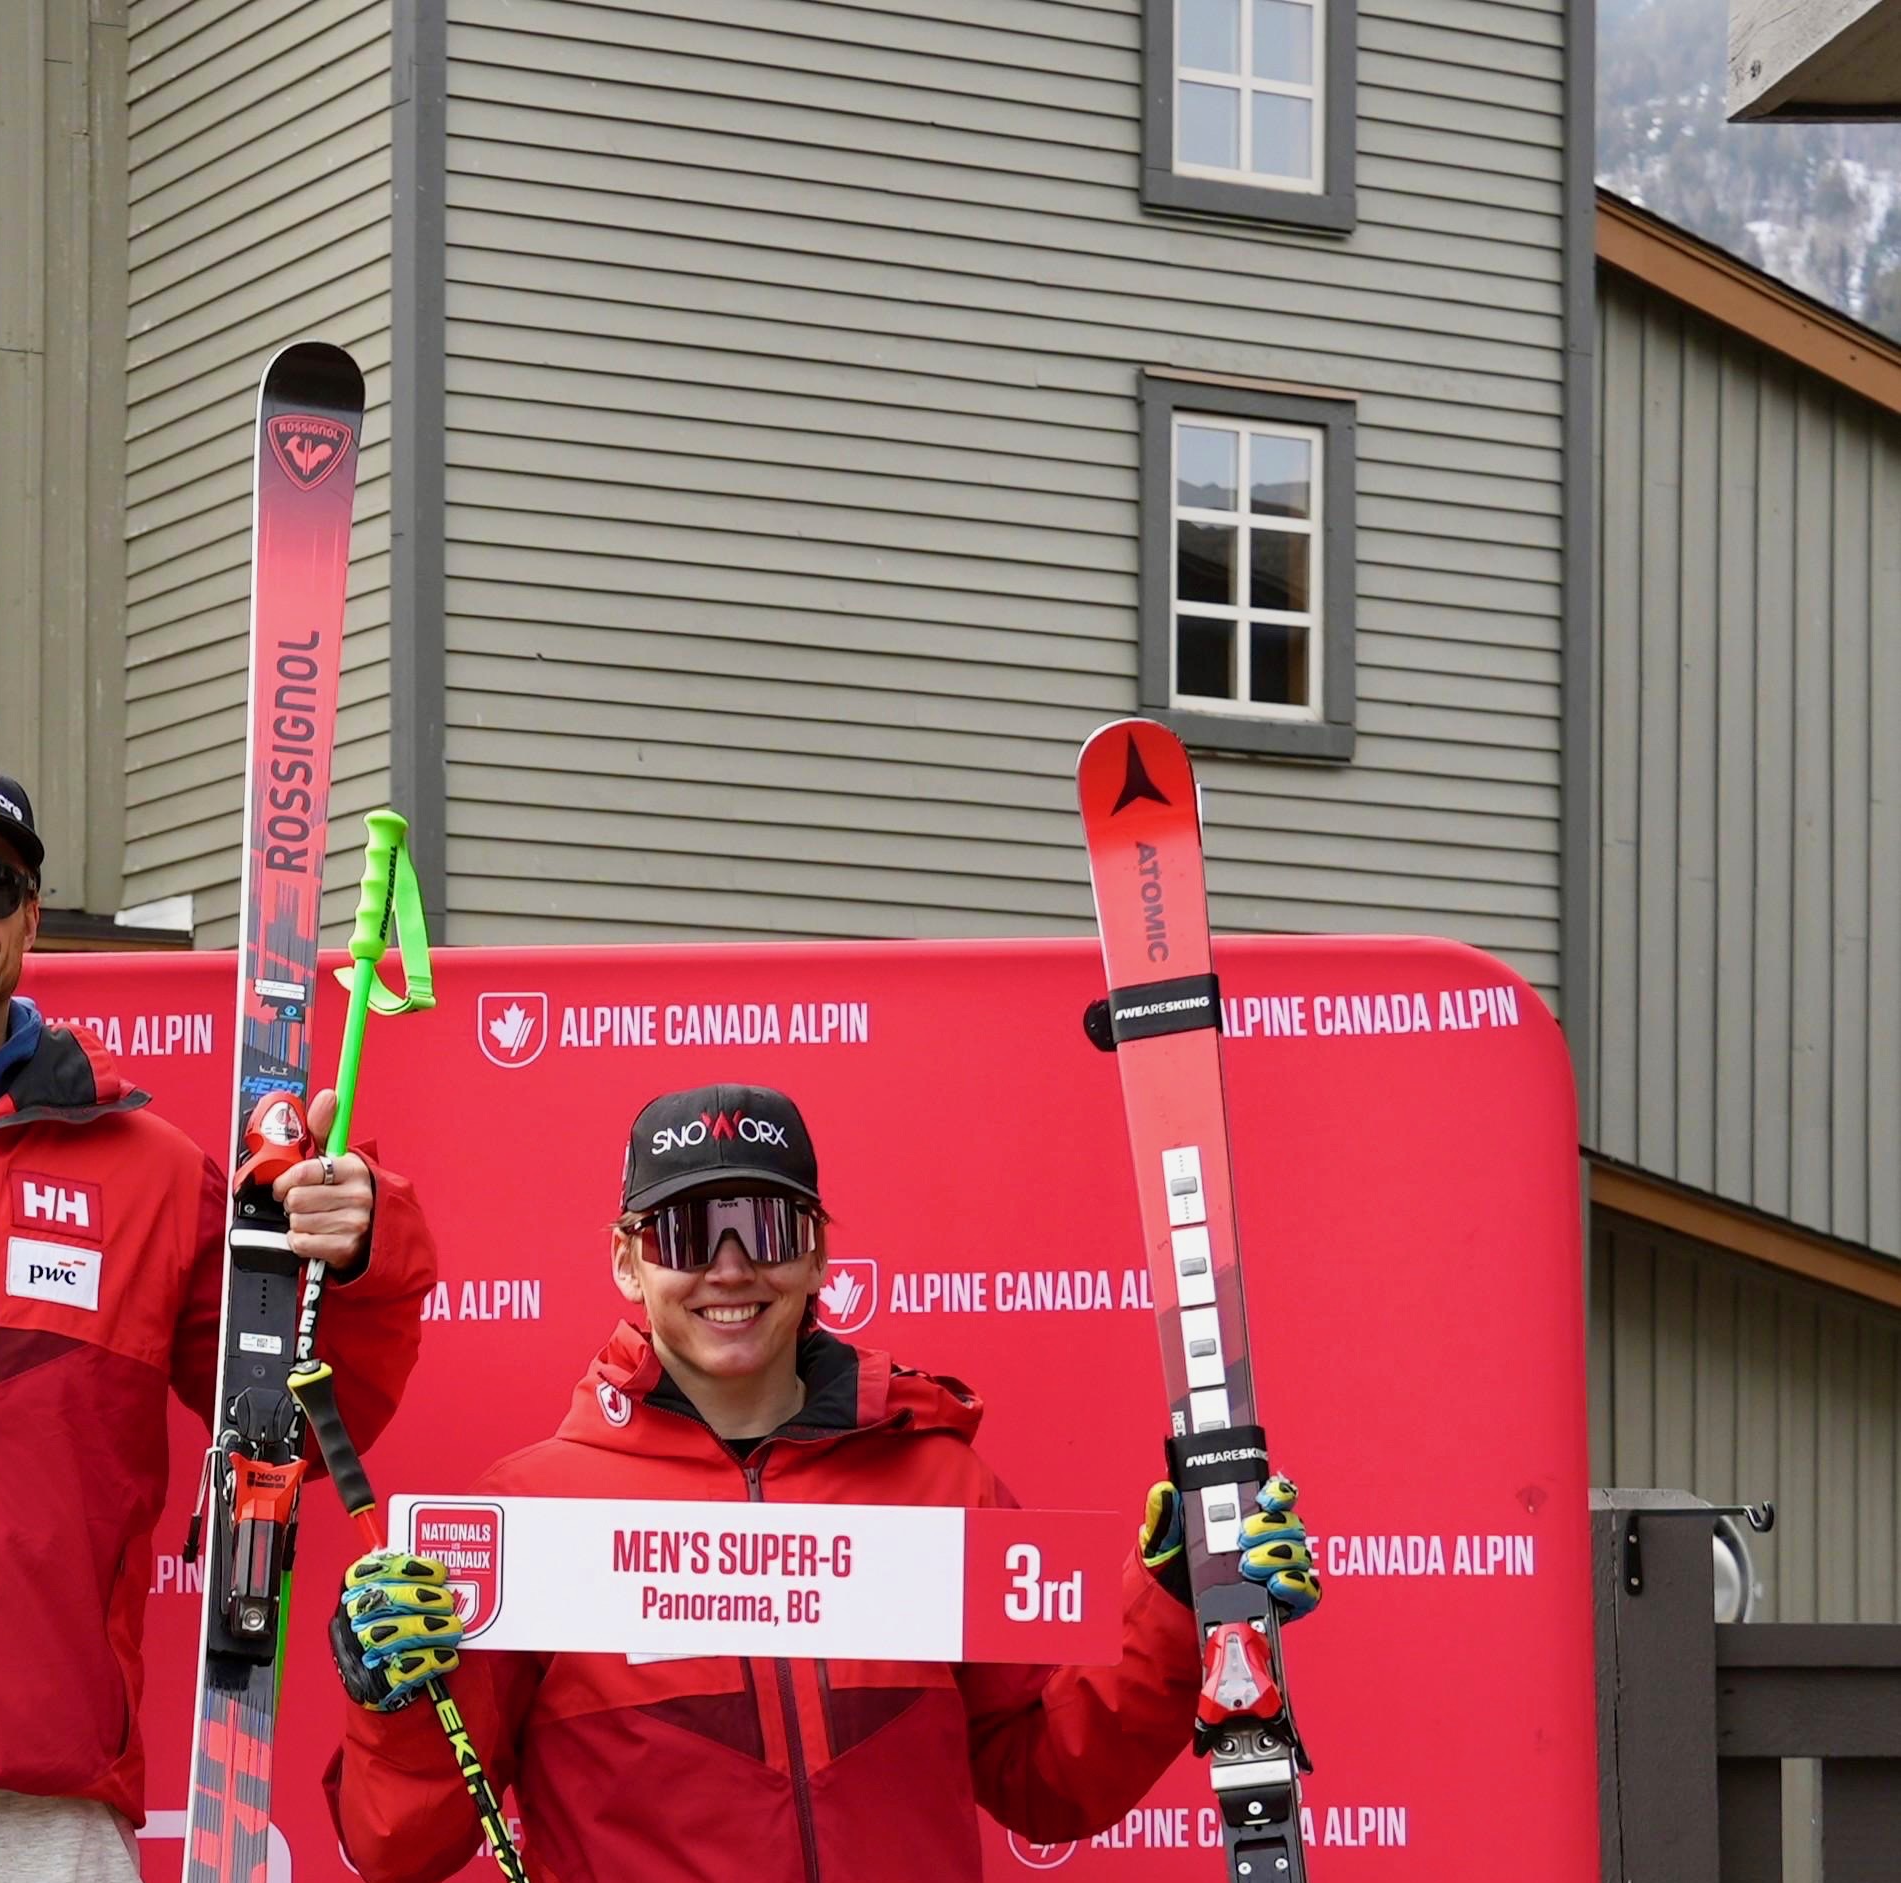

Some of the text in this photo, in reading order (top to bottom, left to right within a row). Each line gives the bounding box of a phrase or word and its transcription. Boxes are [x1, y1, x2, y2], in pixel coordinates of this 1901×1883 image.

[278, 420, 341, 441] ROSSIGNOL
[266, 629, 321, 875] ROSSIGNOL
[1135, 840, 1168, 963] ATOMIC
[560, 1002, 868, 1047] ALPINE CANADA ALPIN
[1115, 996, 1210, 1020] #WEARESKIING
[1313, 993, 1431, 1036] CANADA
[1438, 986, 1519, 1031] ALPIN
[131, 1015, 213, 1055] ALPIN
[22, 1182, 90, 1228] HH
[28, 1263, 78, 1287] pwc
[890, 1272, 987, 1313] ALPINE
[995, 1271, 1113, 1312] CANADA
[459, 1280, 540, 1320] ALPIN
[420, 1522, 491, 1542] NATIONALS
[149, 1555, 205, 1594] PIN
[612, 1530, 853, 1579] MEN'S SUPER-G
[1327, 1536, 1534, 1576] CANADA ALPIN
[1003, 1543, 1084, 1625] 3rd
[640, 1585, 821, 1627] Panorama, BC
[1091, 1808, 1189, 1848] ALPINE
[1323, 1807, 1406, 1846] ALPIN
